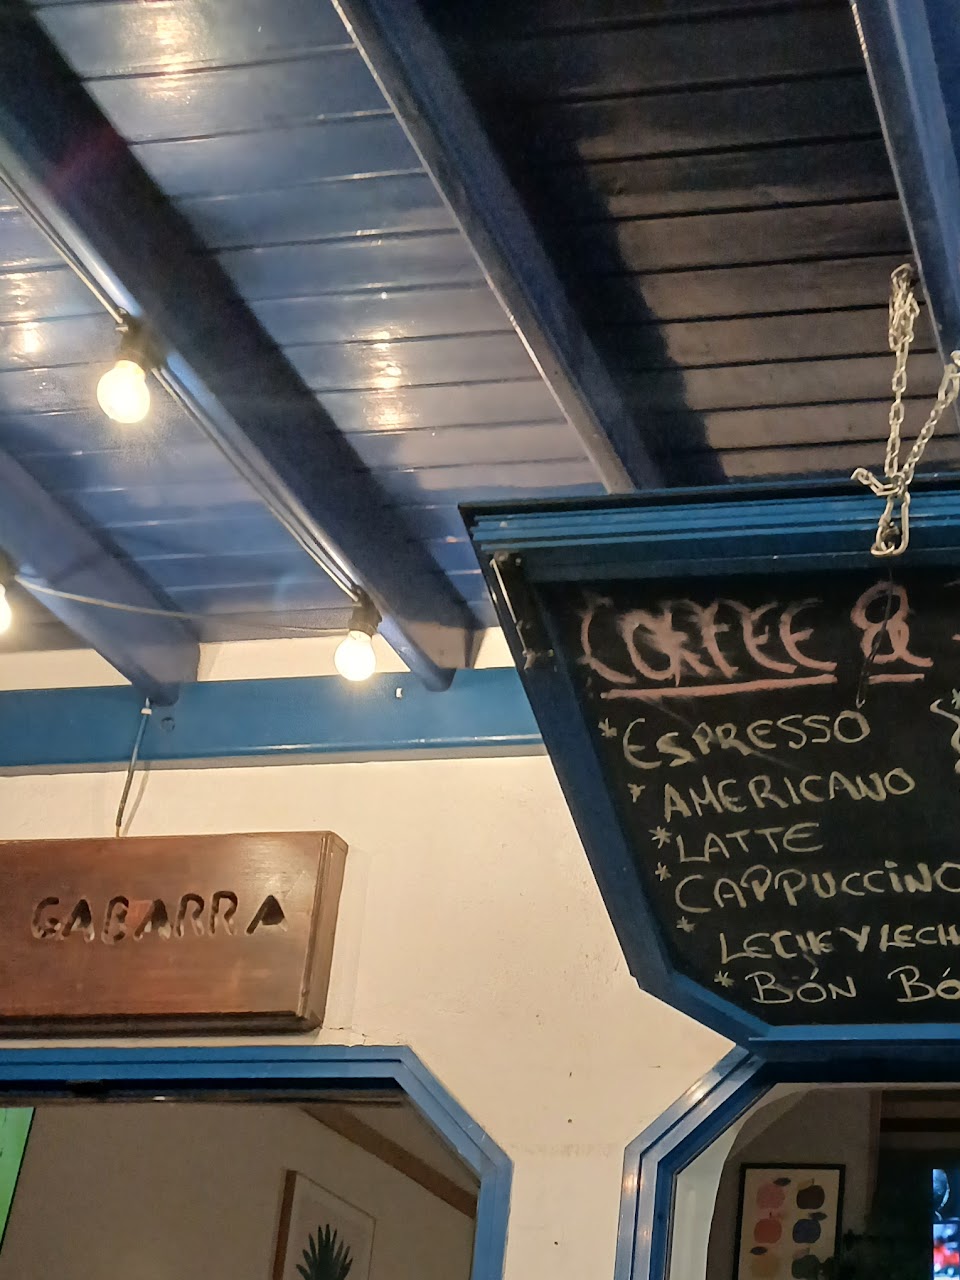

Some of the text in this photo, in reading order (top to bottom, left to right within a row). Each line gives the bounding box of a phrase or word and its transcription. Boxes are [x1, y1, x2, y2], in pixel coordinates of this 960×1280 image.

[851, 580, 933, 668] &
[622, 710, 870, 770] ESPRESSO
[663, 768, 916, 823] AMERICANO
[676, 822, 824, 863] LATTE
[31, 889, 288, 944] GABARRA
